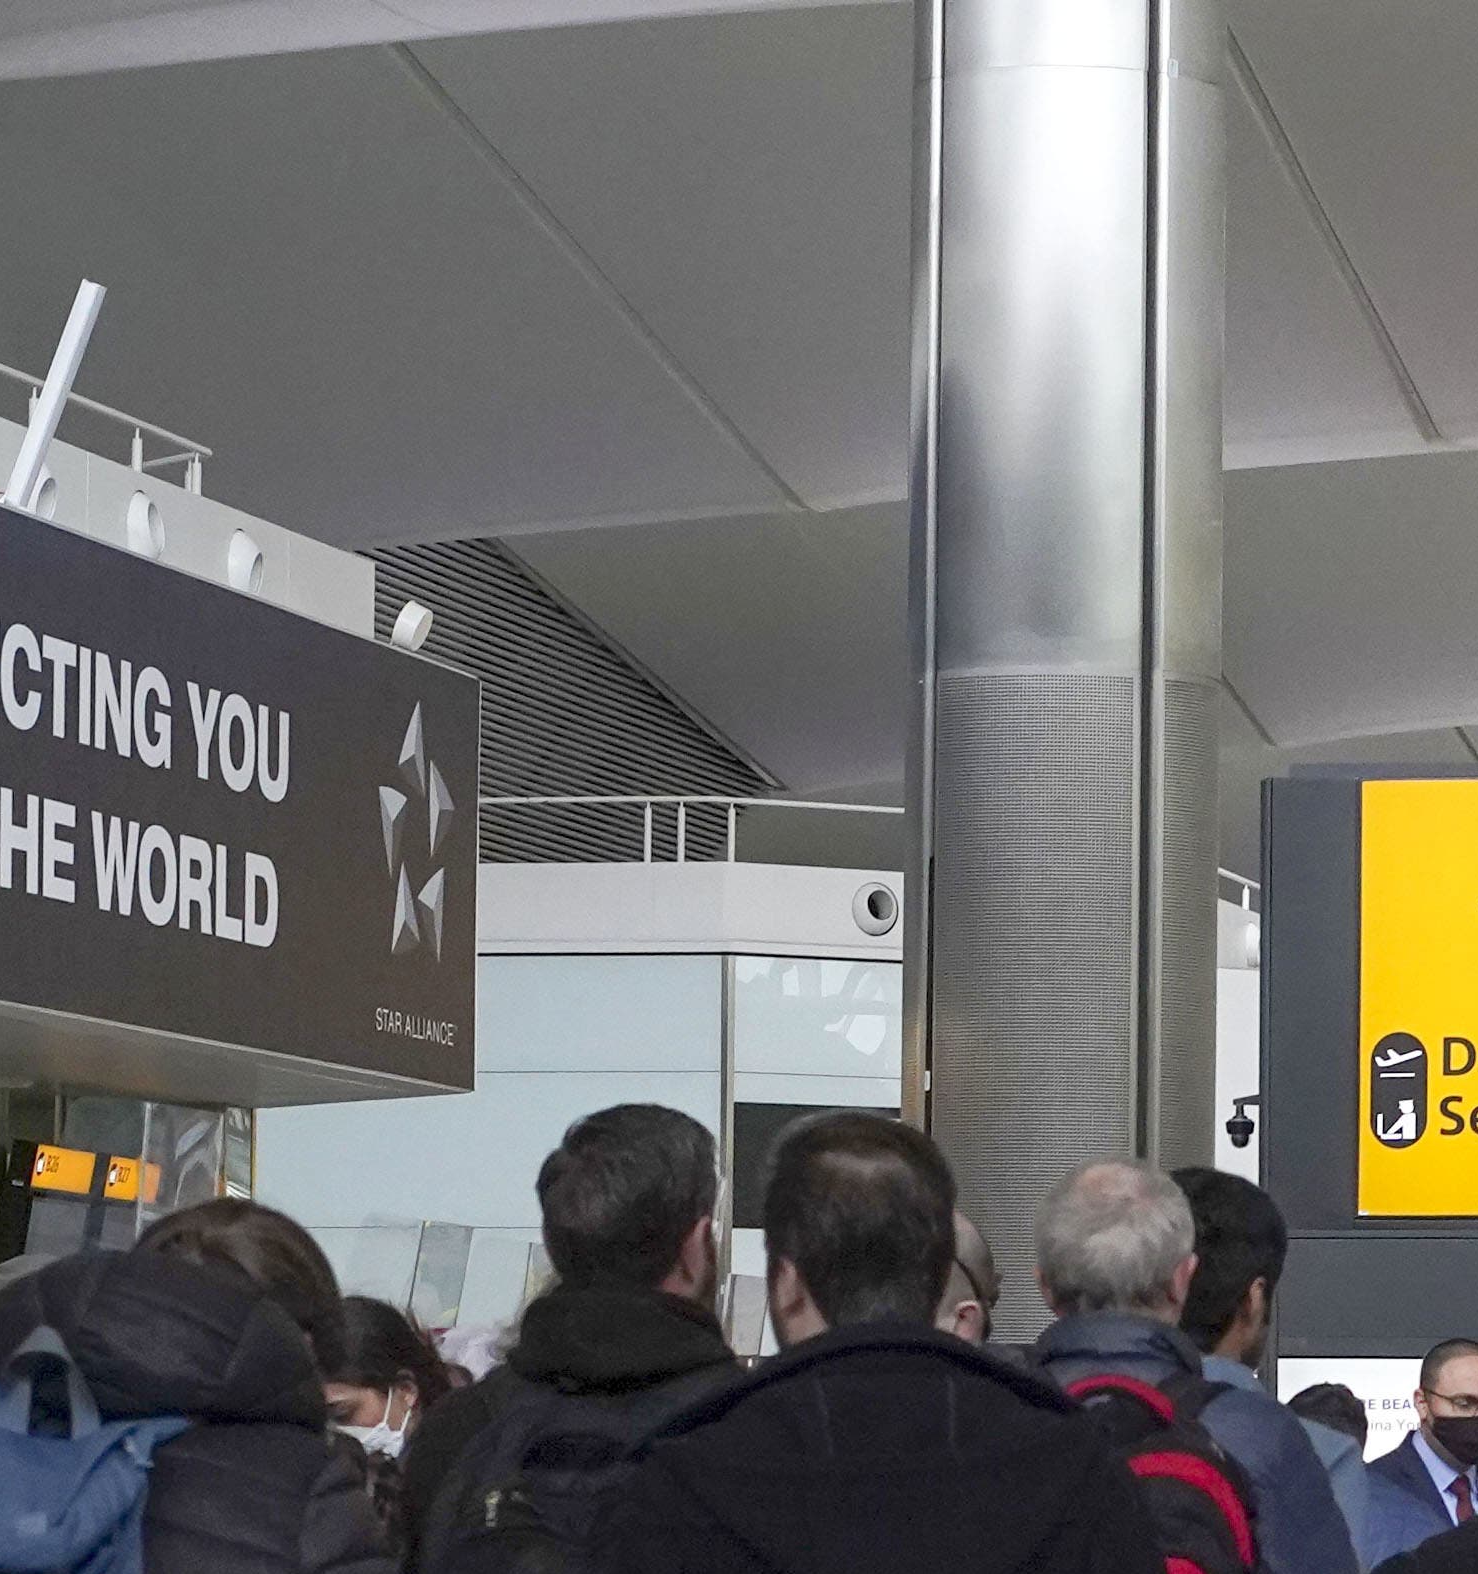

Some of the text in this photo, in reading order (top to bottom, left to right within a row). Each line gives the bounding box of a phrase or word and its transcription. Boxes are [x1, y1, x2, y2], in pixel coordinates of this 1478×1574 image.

[187, 681, 290, 803] YOU
[90, 809, 278, 949] WORLD
[376, 1007, 403, 1034] STAR
